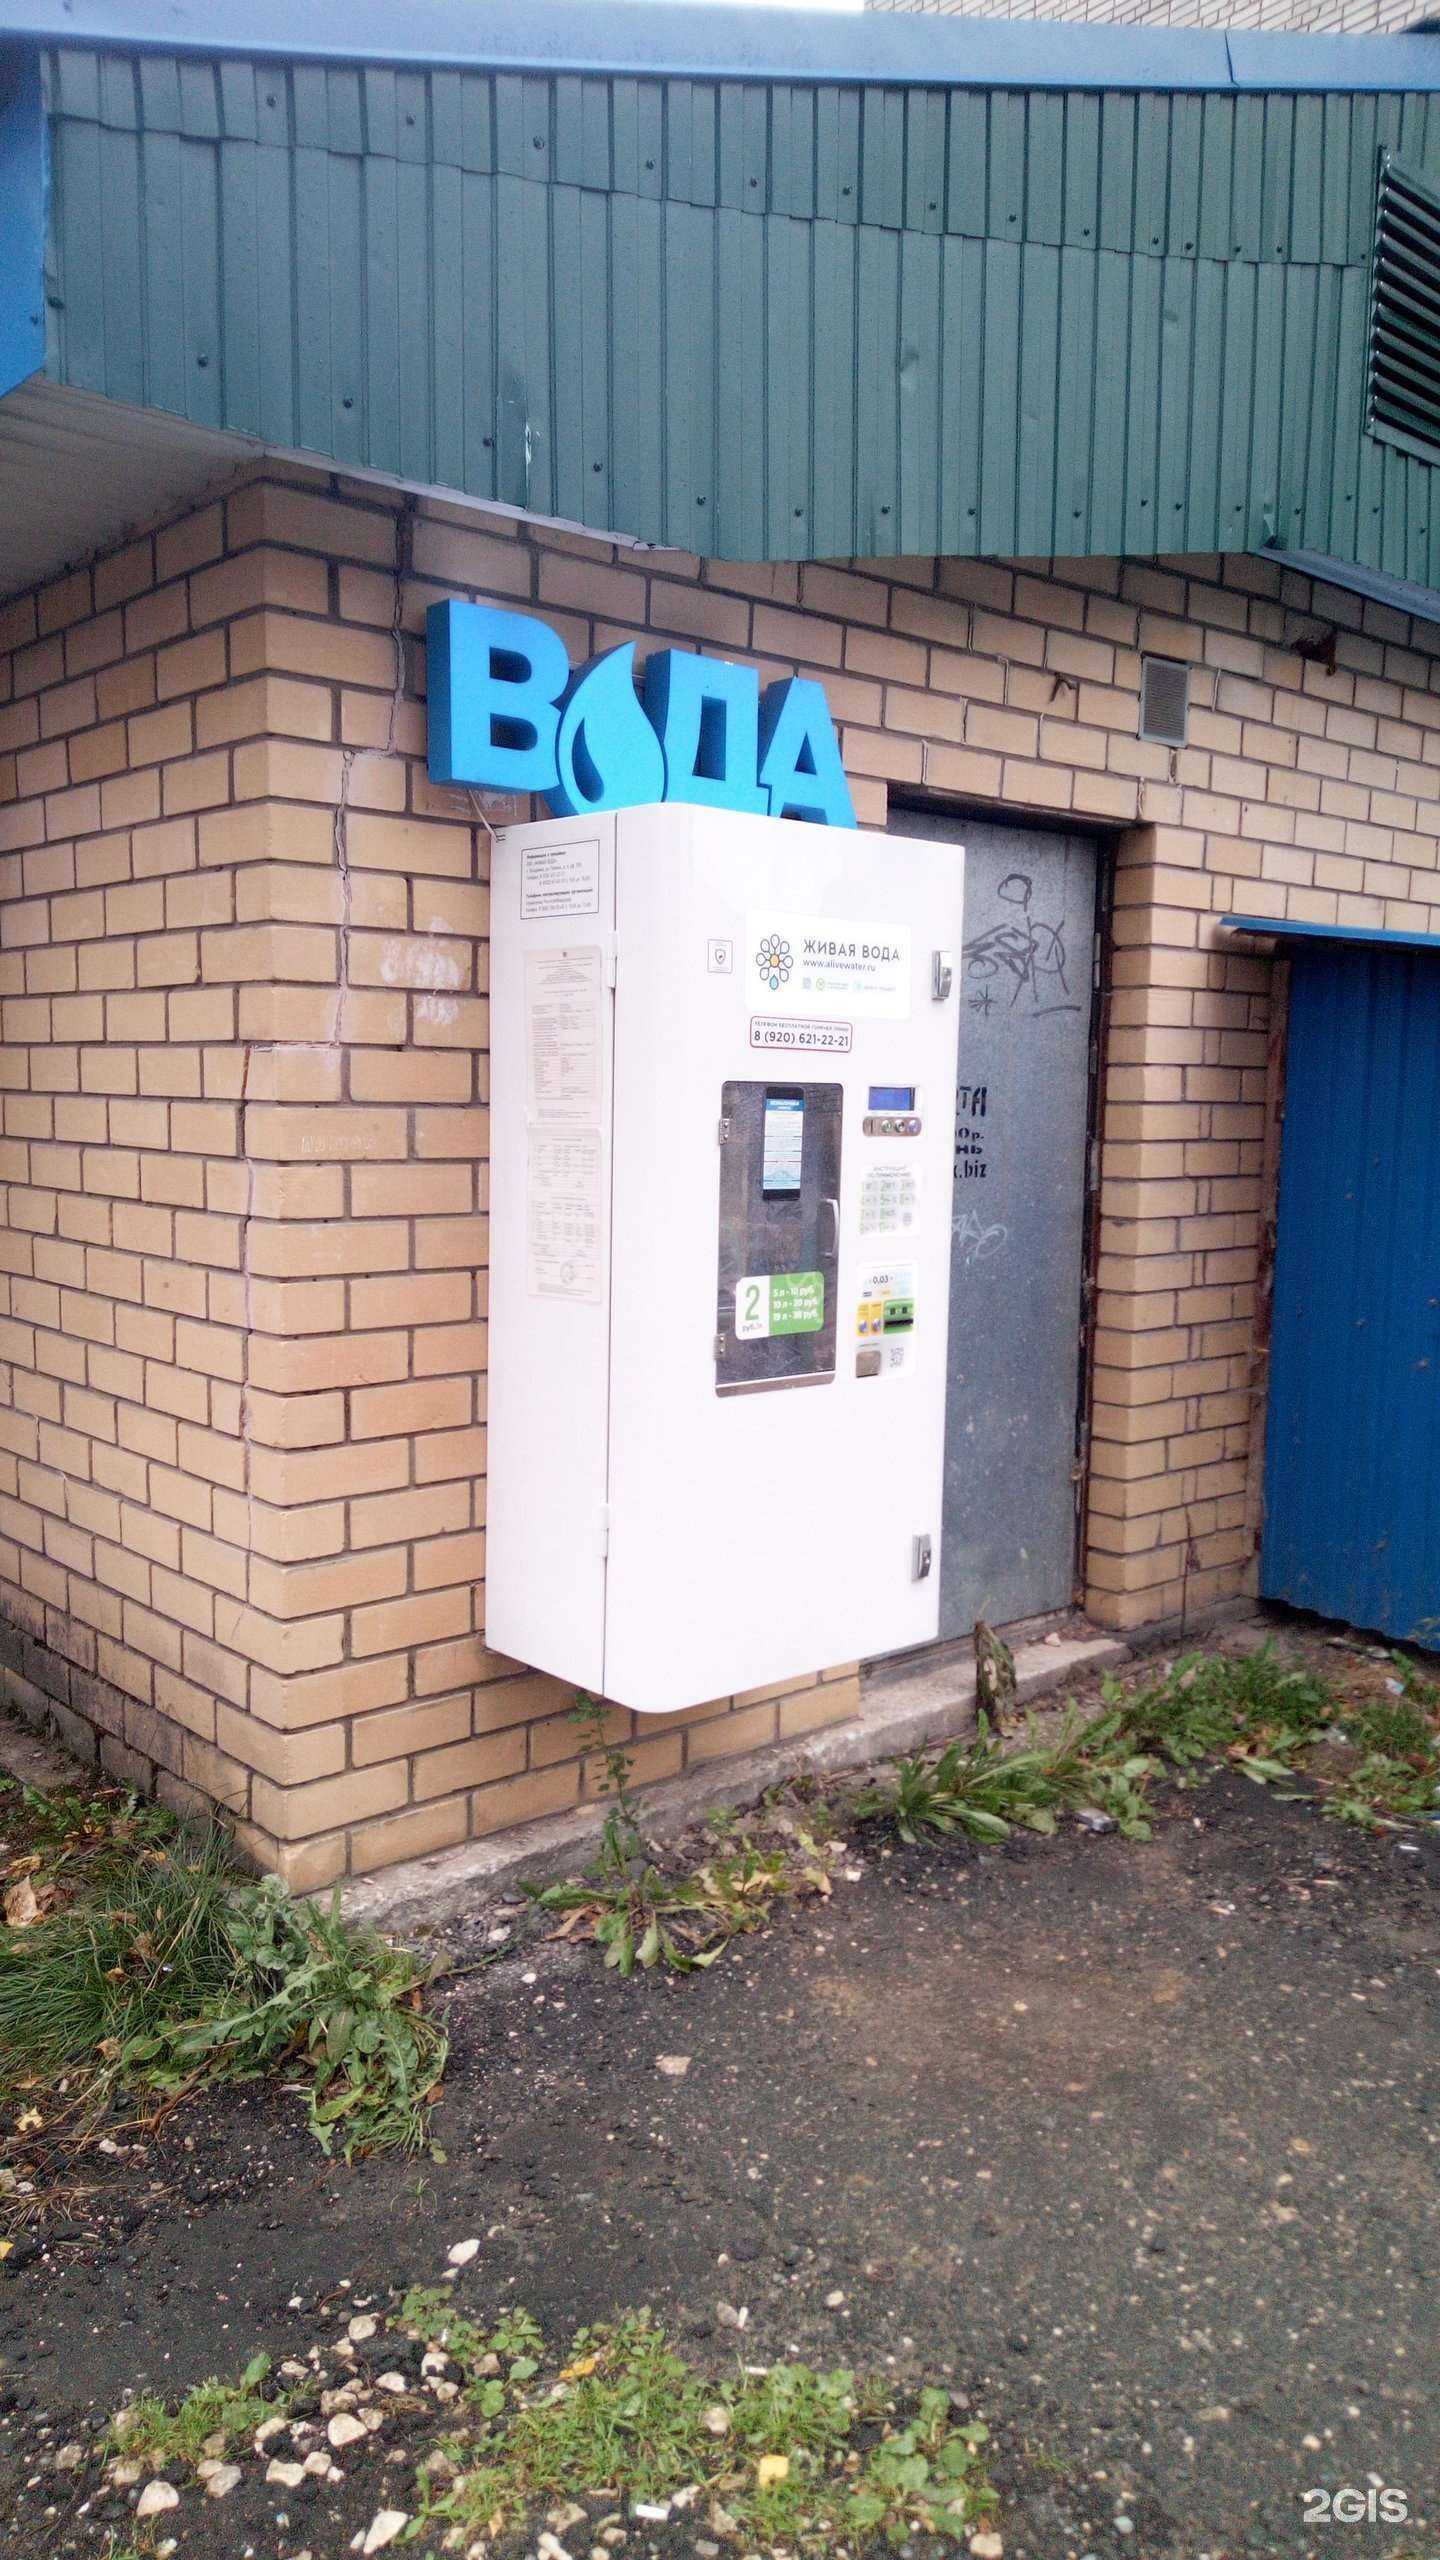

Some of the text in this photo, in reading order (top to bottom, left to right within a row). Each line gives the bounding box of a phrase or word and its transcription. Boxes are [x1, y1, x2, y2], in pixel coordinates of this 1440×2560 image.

[803, 938, 900, 962] ЖИВАЯ ВОДА
[803, 959, 876, 972] www.alivewater.ru
[754, 1030, 849, 1047] 8 (920) 621-22-21
[745, 1284, 760, 1321] 2
